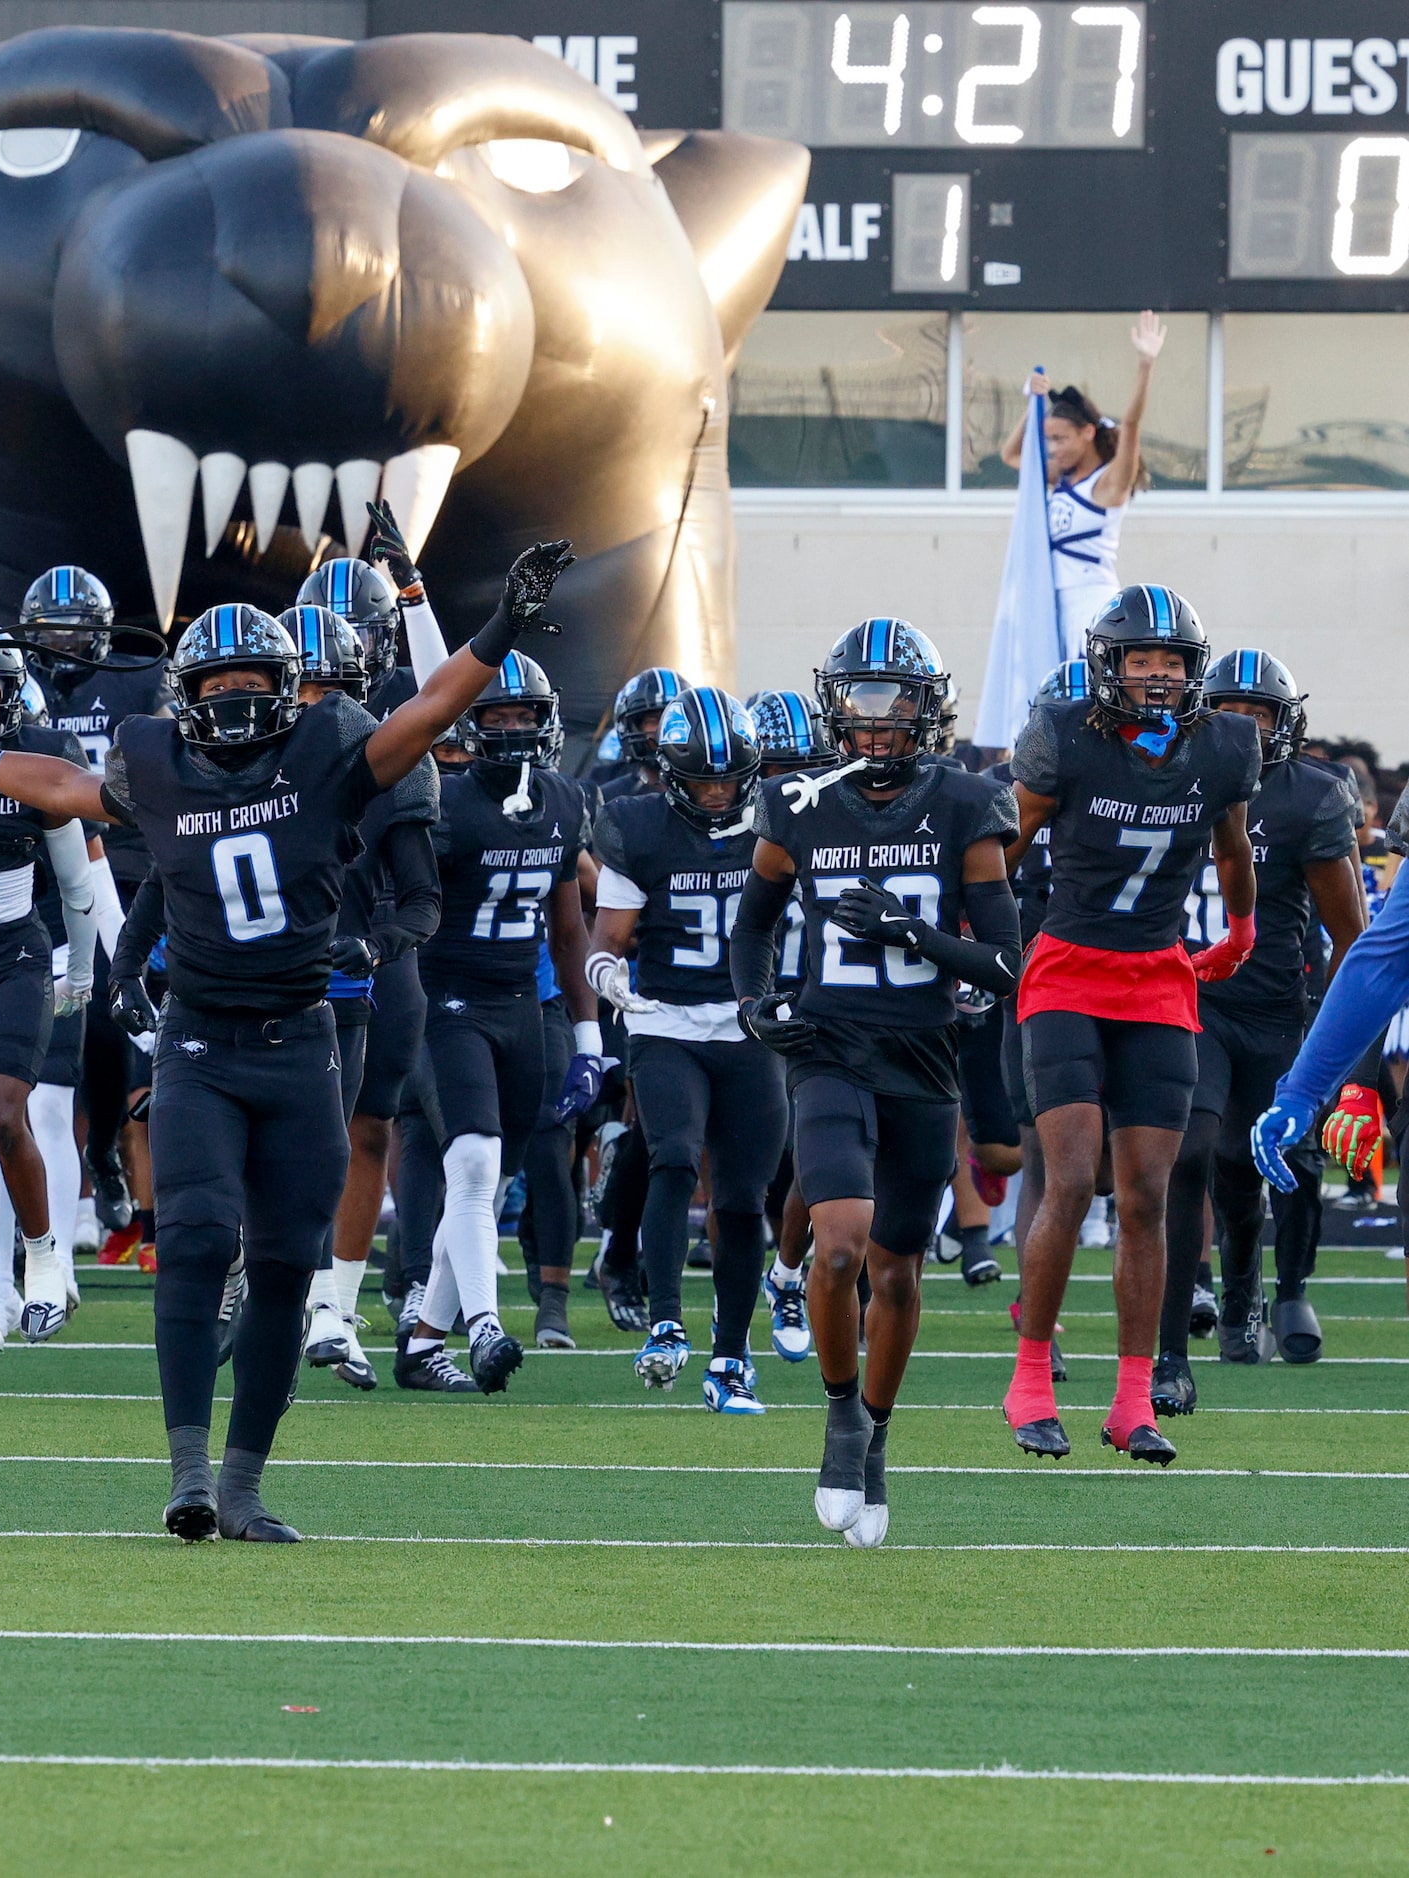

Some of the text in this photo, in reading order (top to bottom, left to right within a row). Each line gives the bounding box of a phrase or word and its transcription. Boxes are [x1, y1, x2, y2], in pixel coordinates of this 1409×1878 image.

[831, 6, 1142, 145] 4:27
[786, 203, 882, 261] ALF
[940, 184, 963, 282] 1
[1330, 136, 1409, 275] 0
[57, 715, 110, 732] CROWLEY
[175, 792, 299, 836] NORTH CROWLEY
[1089, 796, 1204, 825] NORTH CROWLEY
[480, 846, 564, 867] NORTH CROWLEY
[669, 872, 711, 891] NORTH
[811, 843, 941, 870] NORTH CROWLEY
[1108, 826, 1174, 913] 7
[210, 830, 290, 943] 0
[470, 870, 555, 939] 13
